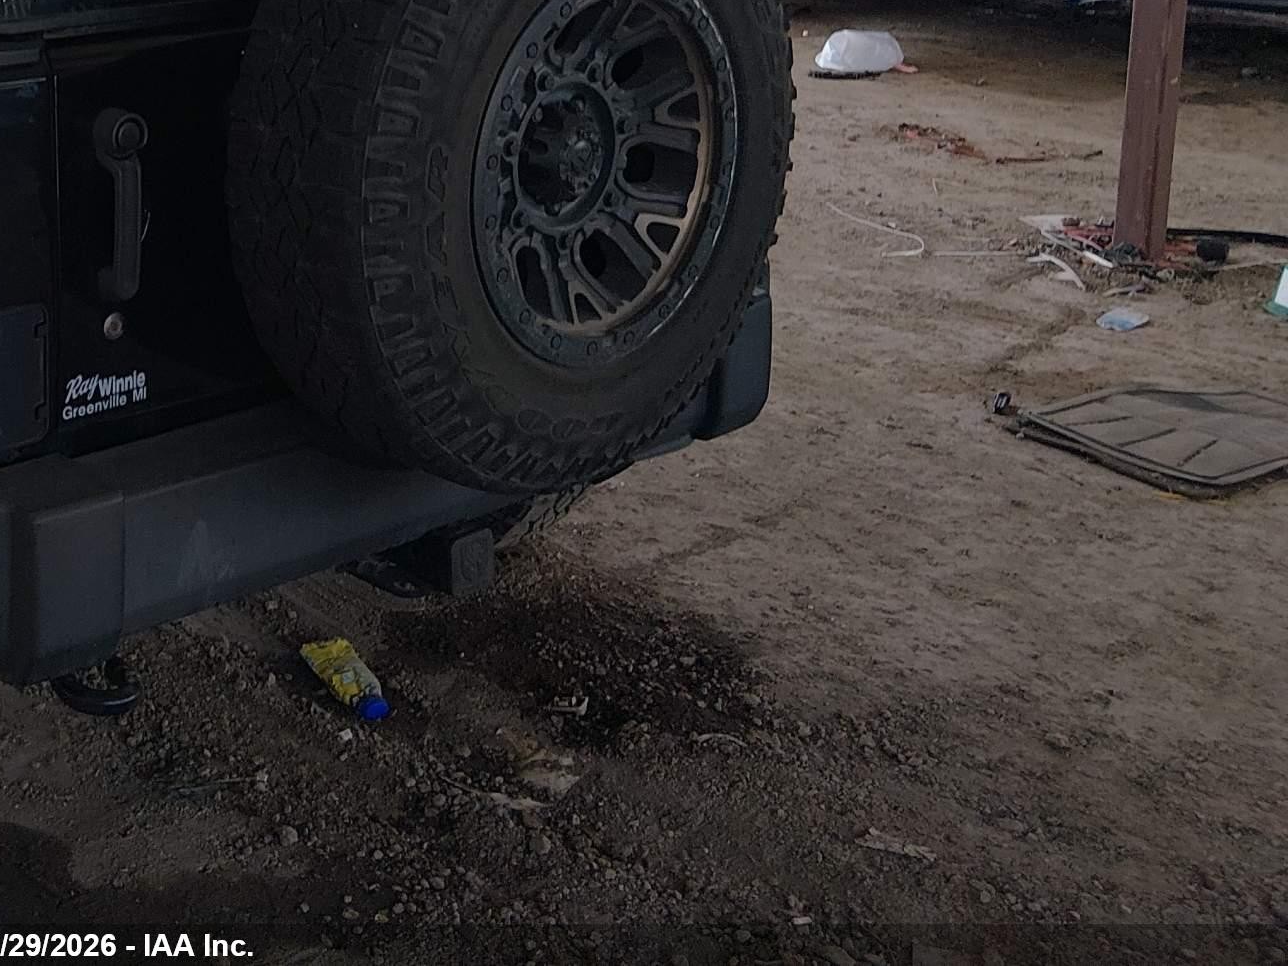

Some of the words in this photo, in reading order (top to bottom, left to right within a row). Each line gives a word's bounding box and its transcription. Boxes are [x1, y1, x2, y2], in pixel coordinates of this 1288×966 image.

[62, 395, 127, 420] Greenville
[133, 386, 147, 402] MI
[65, 374, 100, 404] Ray
[99, 370, 146, 397] Winnie
